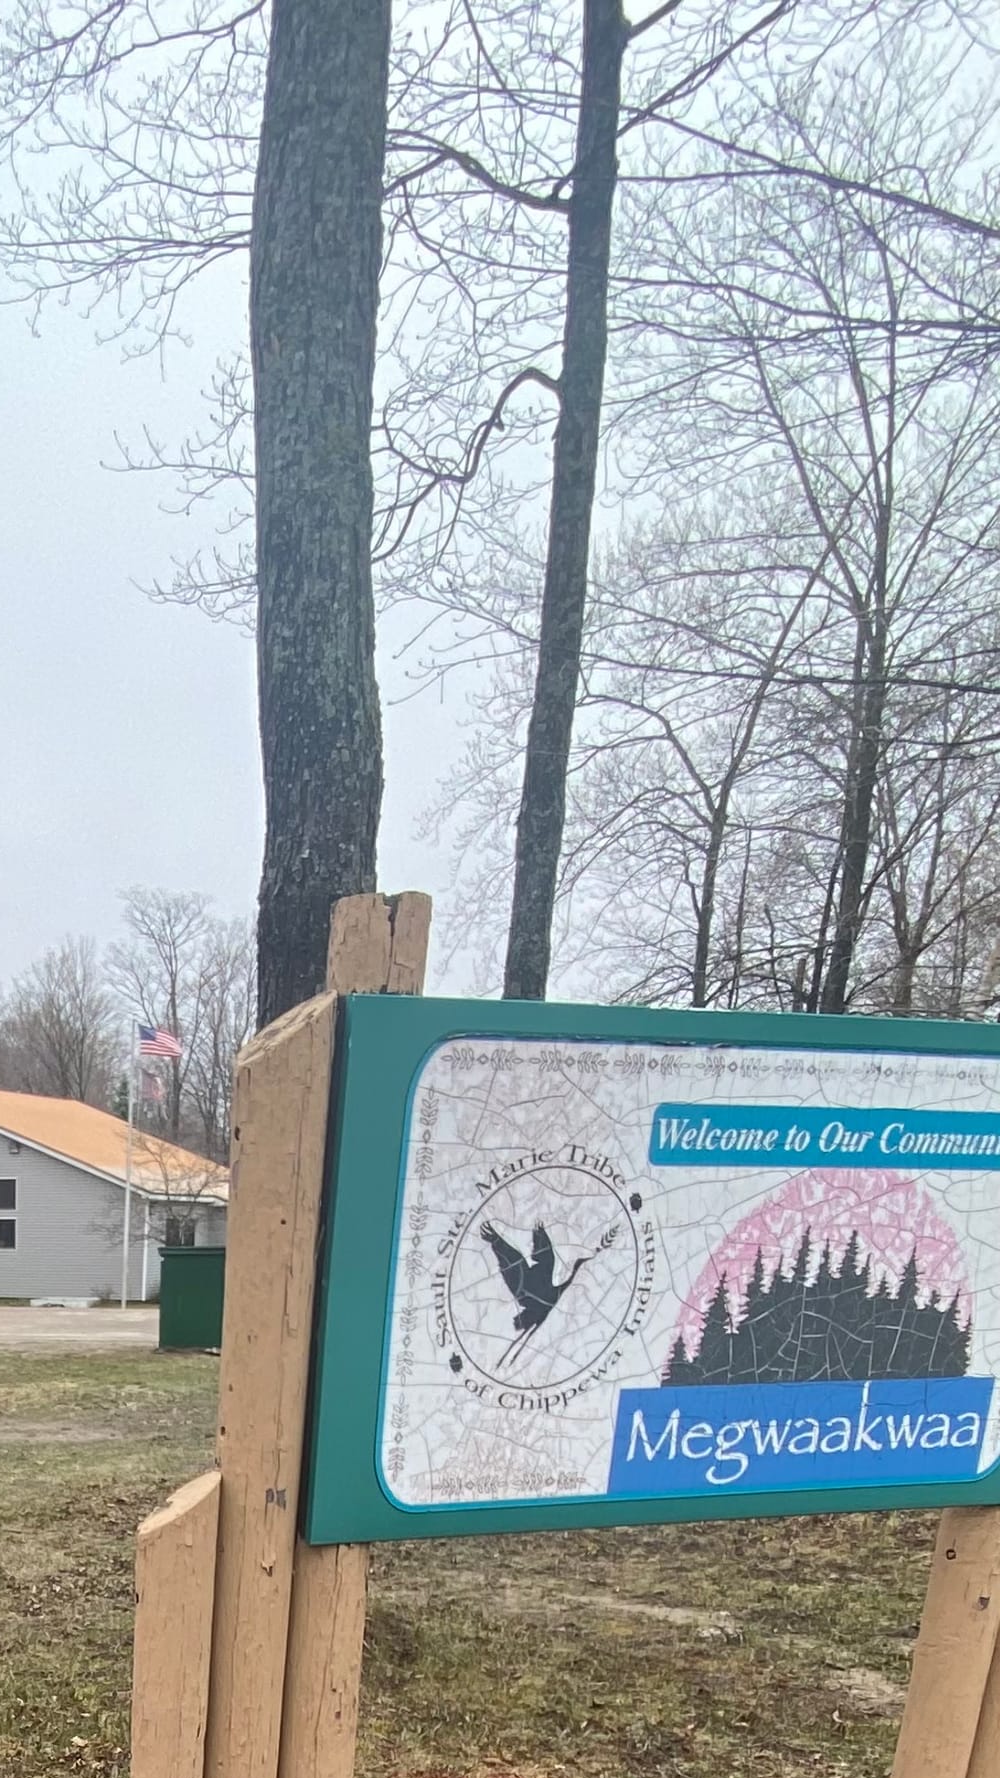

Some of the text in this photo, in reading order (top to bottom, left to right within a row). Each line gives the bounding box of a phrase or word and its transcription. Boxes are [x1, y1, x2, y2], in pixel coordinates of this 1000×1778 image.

[658, 1118, 776, 1150] Welcome
[784, 1123, 810, 1152] to
[819, 1121, 874, 1153] Our
[431, 1272, 452, 1348] Sault
[475, 1148, 553, 1198] Marie
[566, 1144, 627, 1190] Tribe
[464, 1221, 655, 1413] of Chippewa Indians
[626, 1381, 981, 1485] Megwaakwaa
